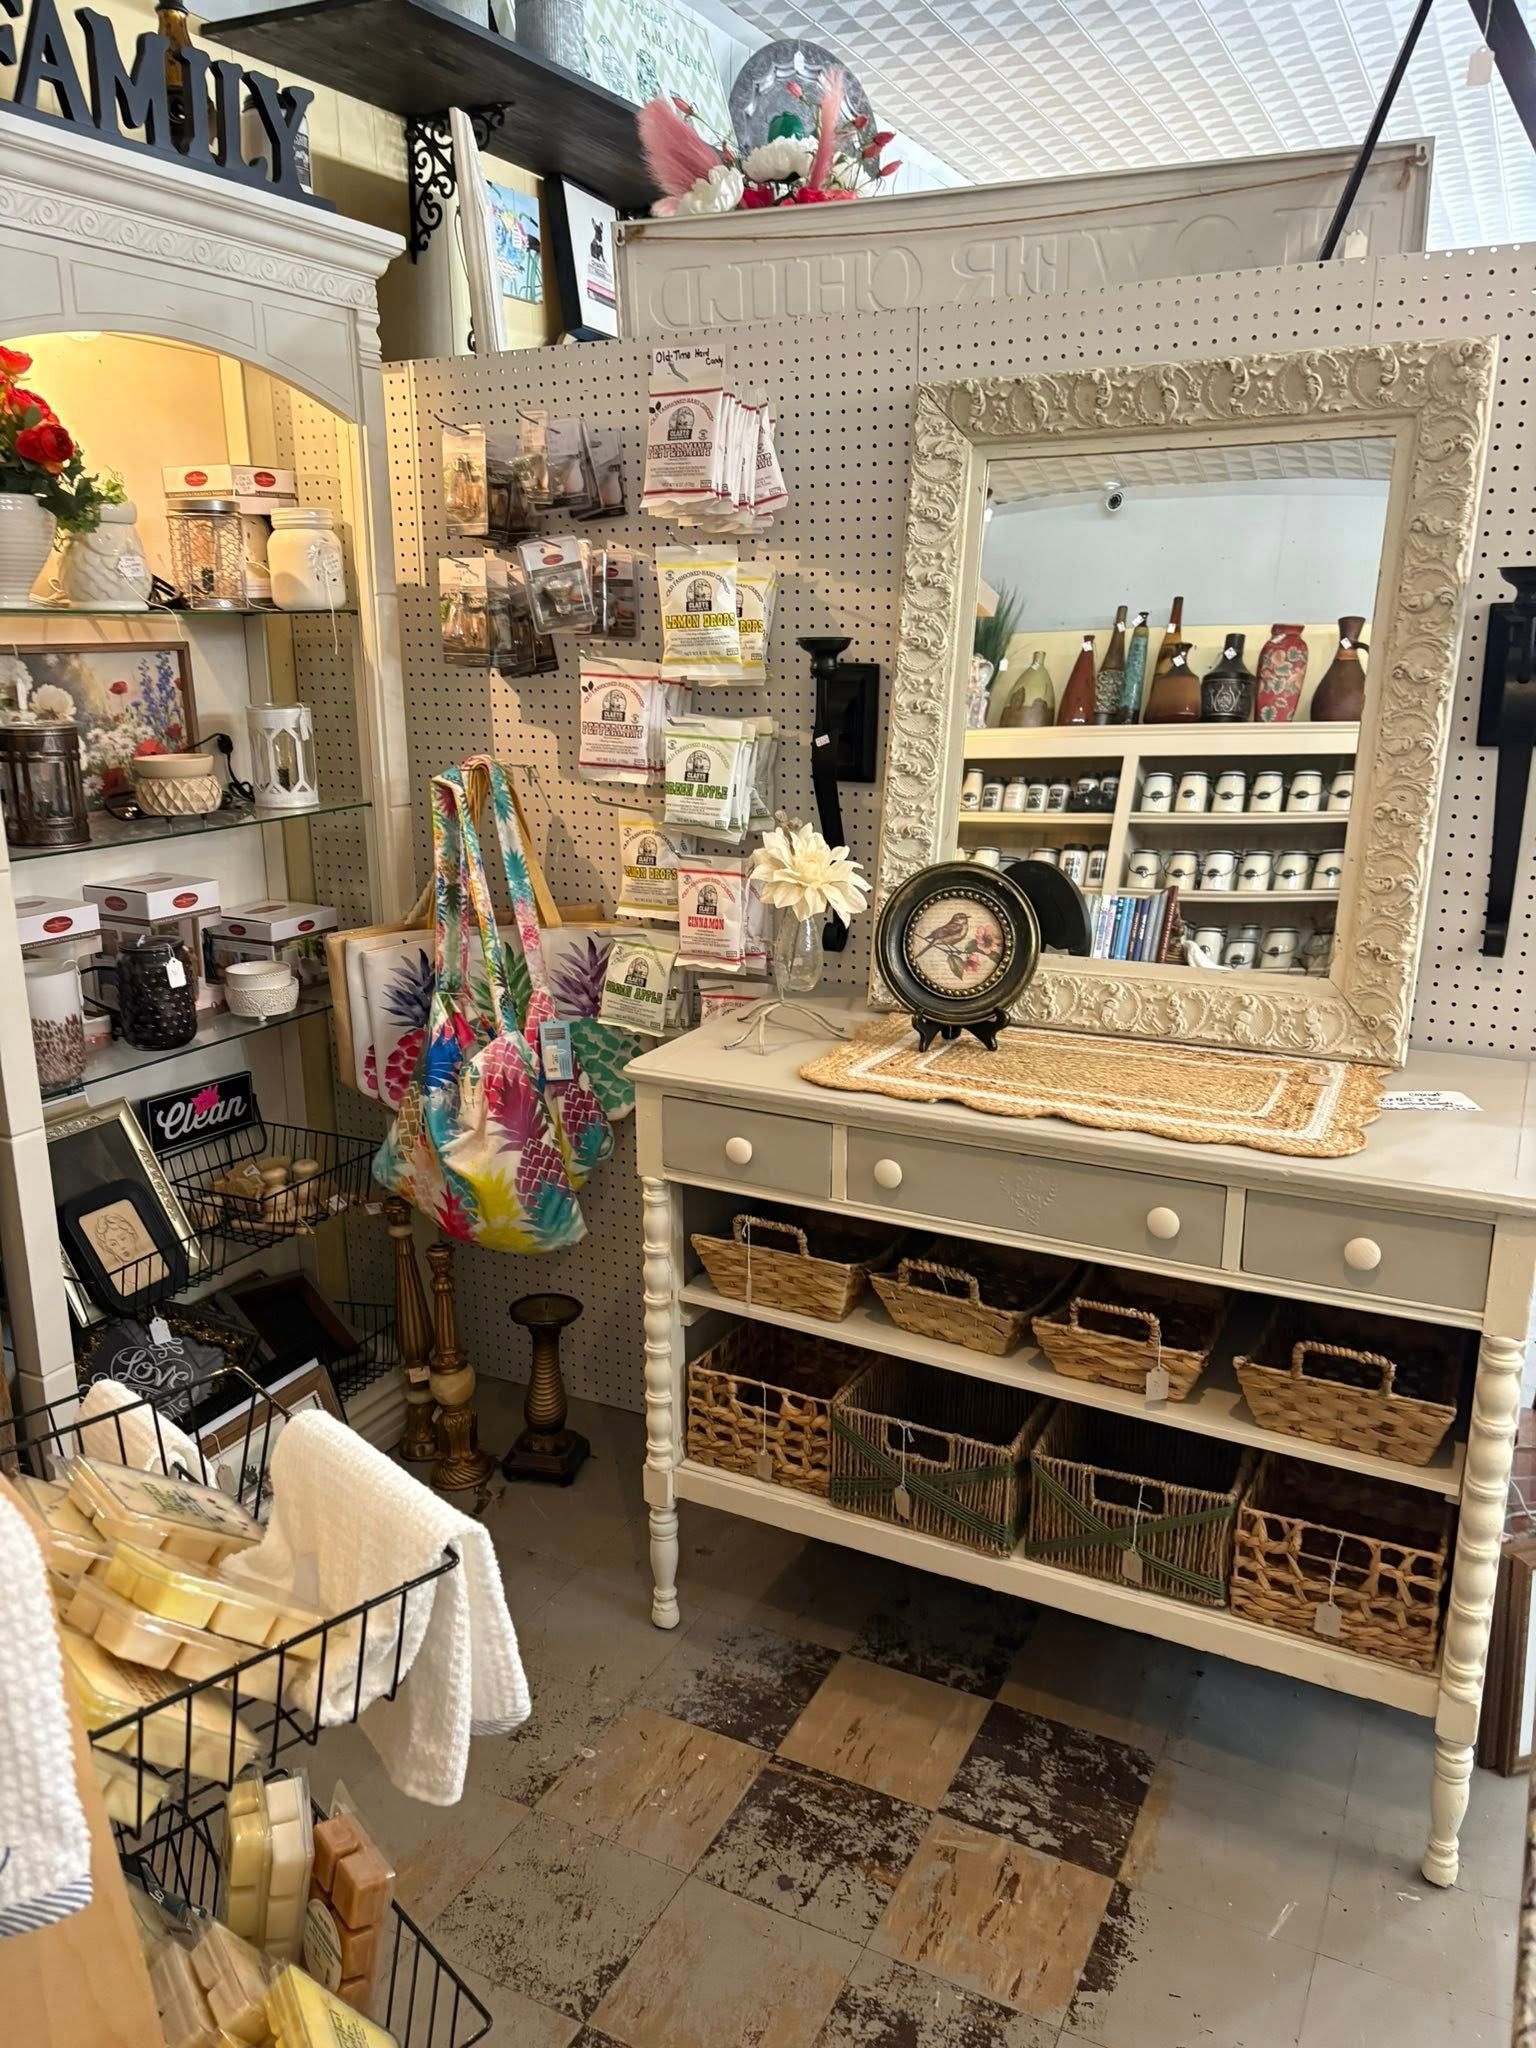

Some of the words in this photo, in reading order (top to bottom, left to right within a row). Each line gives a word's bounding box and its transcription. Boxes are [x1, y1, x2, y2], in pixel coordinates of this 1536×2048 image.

[694, 348, 710, 358] Hard
[705, 355, 724, 368] Candy
[647, 442, 712, 460] PEPPERMINT
[665, 614, 700, 630] LEMON
[703, 612, 736, 627] DROPS
[582, 721, 644, 739] PEPPERMINT
[696, 783, 728, 800] APPLE
[649, 867, 678, 881] DROPS
[687, 916, 724, 930] CINNAMON
[634, 987, 664, 1005] APPLE
[156, 1095, 247, 1140] Clean
[115, 1350, 189, 1389] Love
